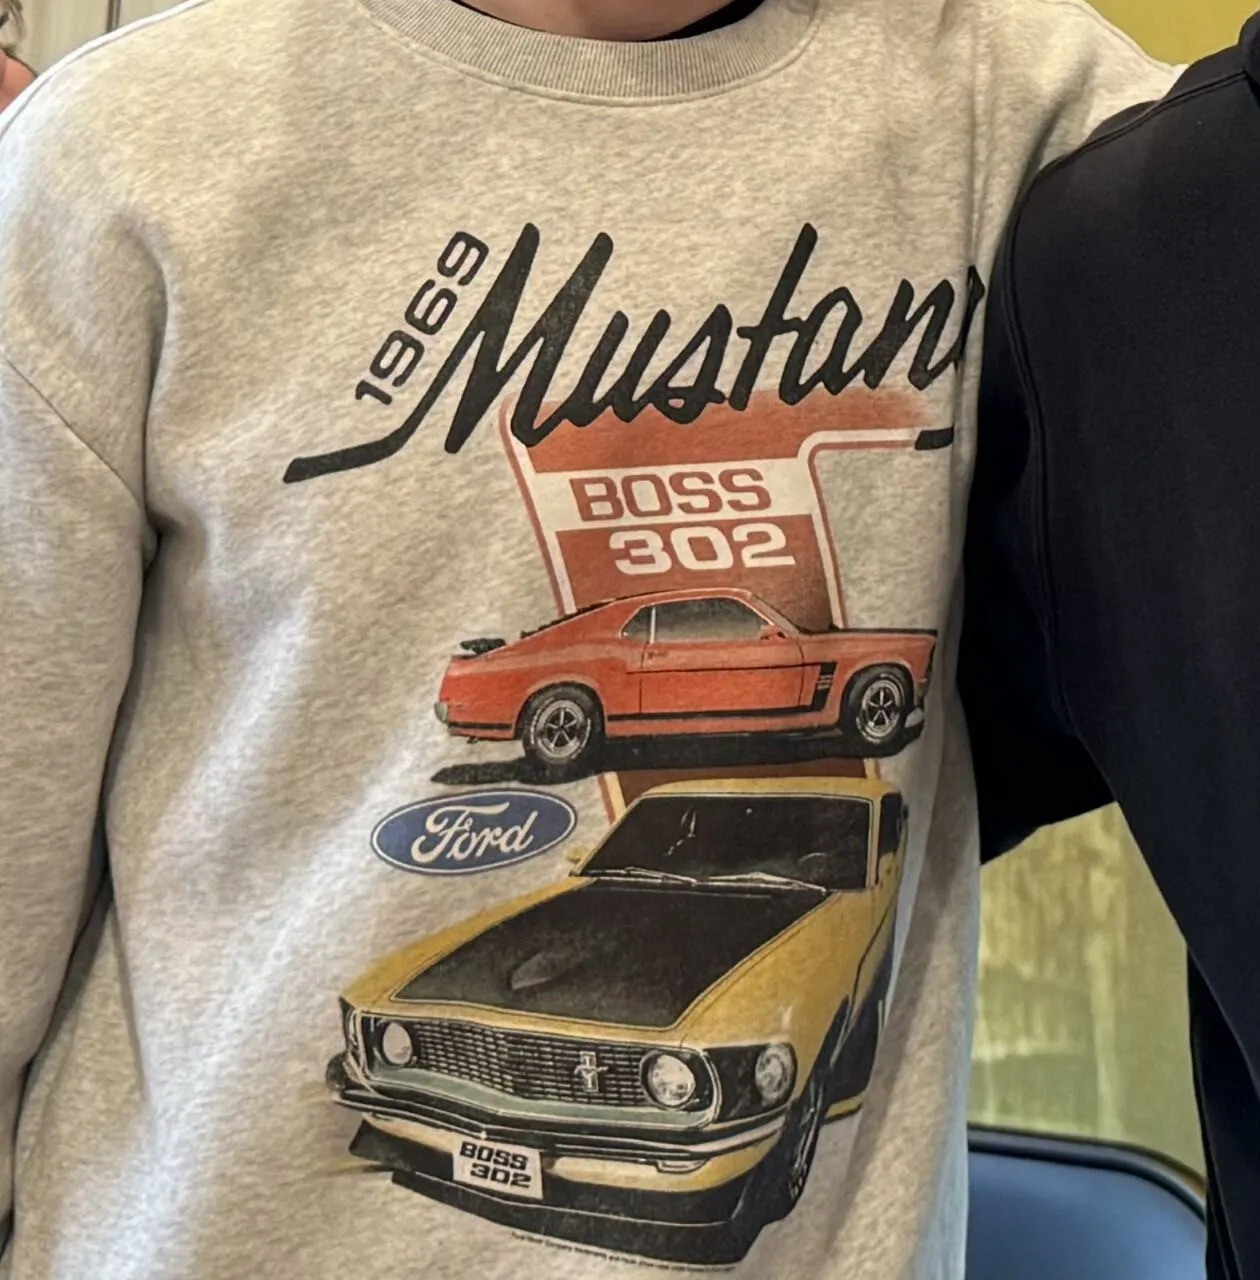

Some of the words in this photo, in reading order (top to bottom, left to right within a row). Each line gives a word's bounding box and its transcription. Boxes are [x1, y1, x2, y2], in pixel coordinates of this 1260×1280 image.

[355, 230, 490, 406] 1969
[569, 468, 772, 522] BOSS
[609, 521, 796, 576] 302
[411, 801, 538, 864] Ford
[460, 1141, 528, 1171] BOSS
[470, 1163, 531, 1189] 302
